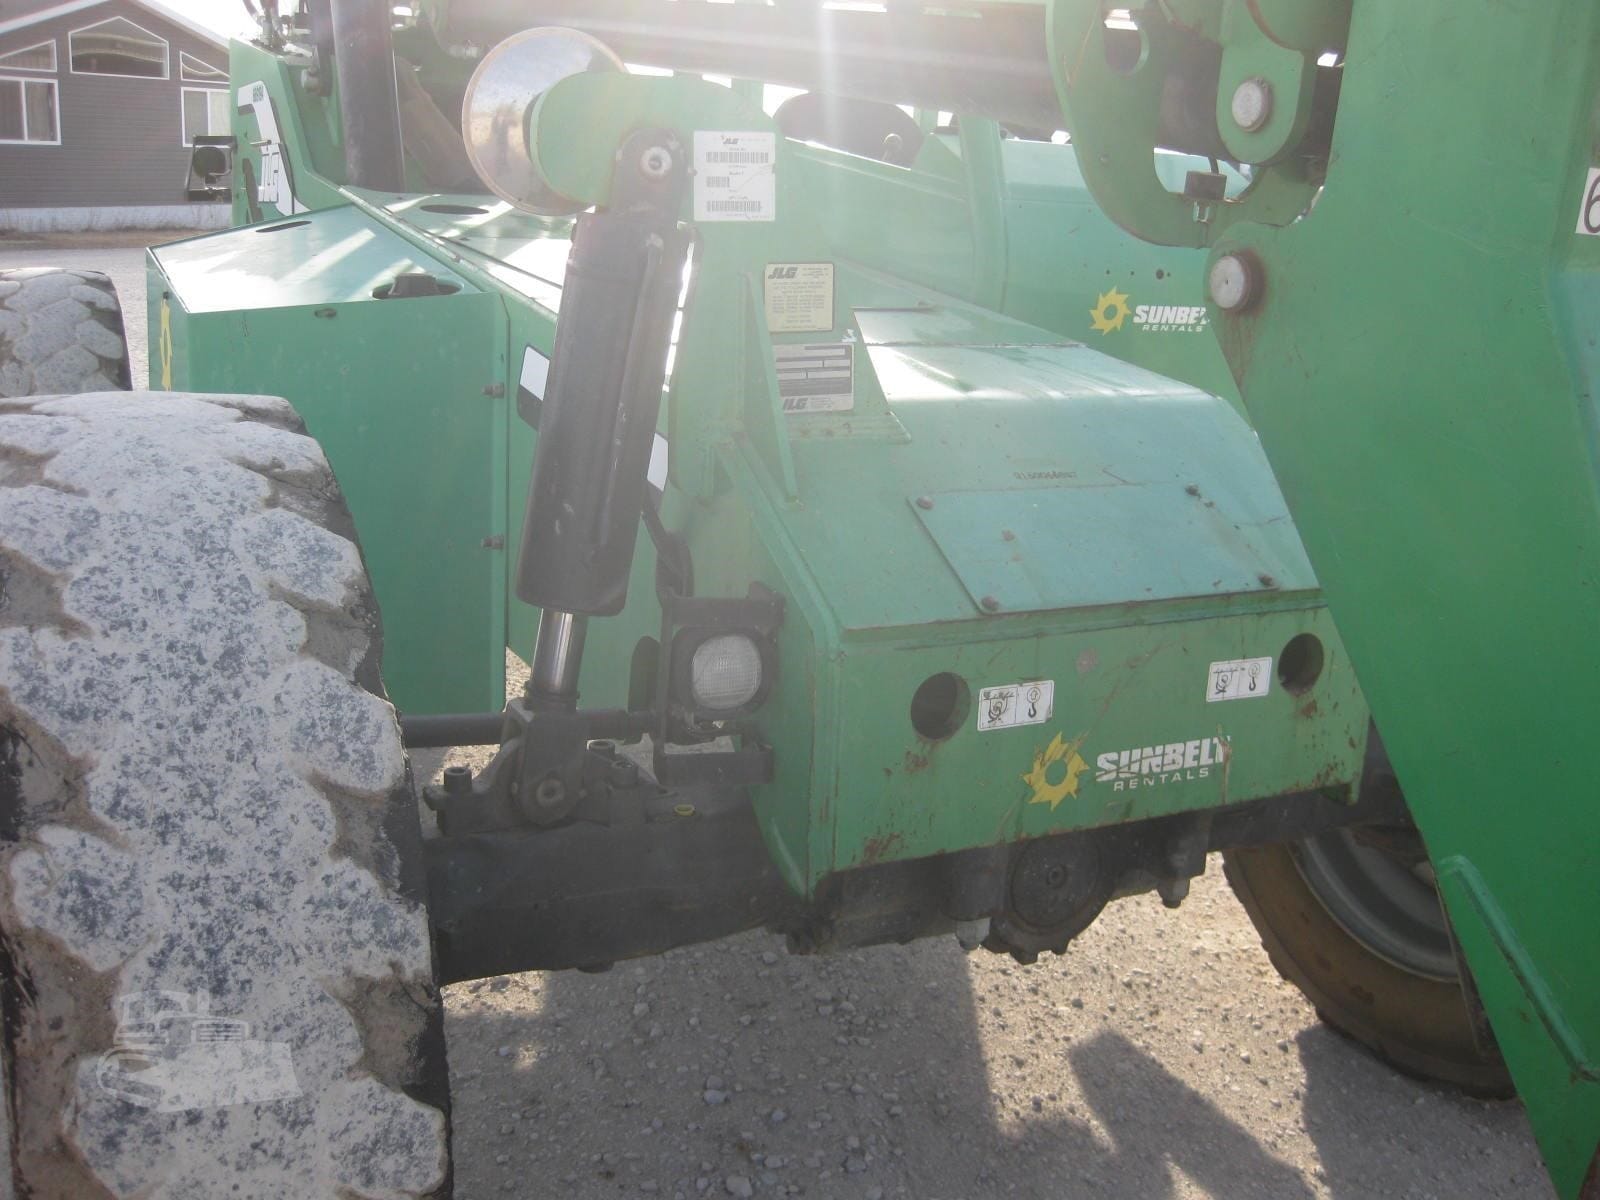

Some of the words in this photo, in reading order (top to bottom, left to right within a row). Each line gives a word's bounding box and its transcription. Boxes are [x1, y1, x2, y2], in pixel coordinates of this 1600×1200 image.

[768, 267, 798, 280] JLG
[1142, 324, 1203, 332] RENTALS
[1113, 767, 1209, 791] RENTALS
